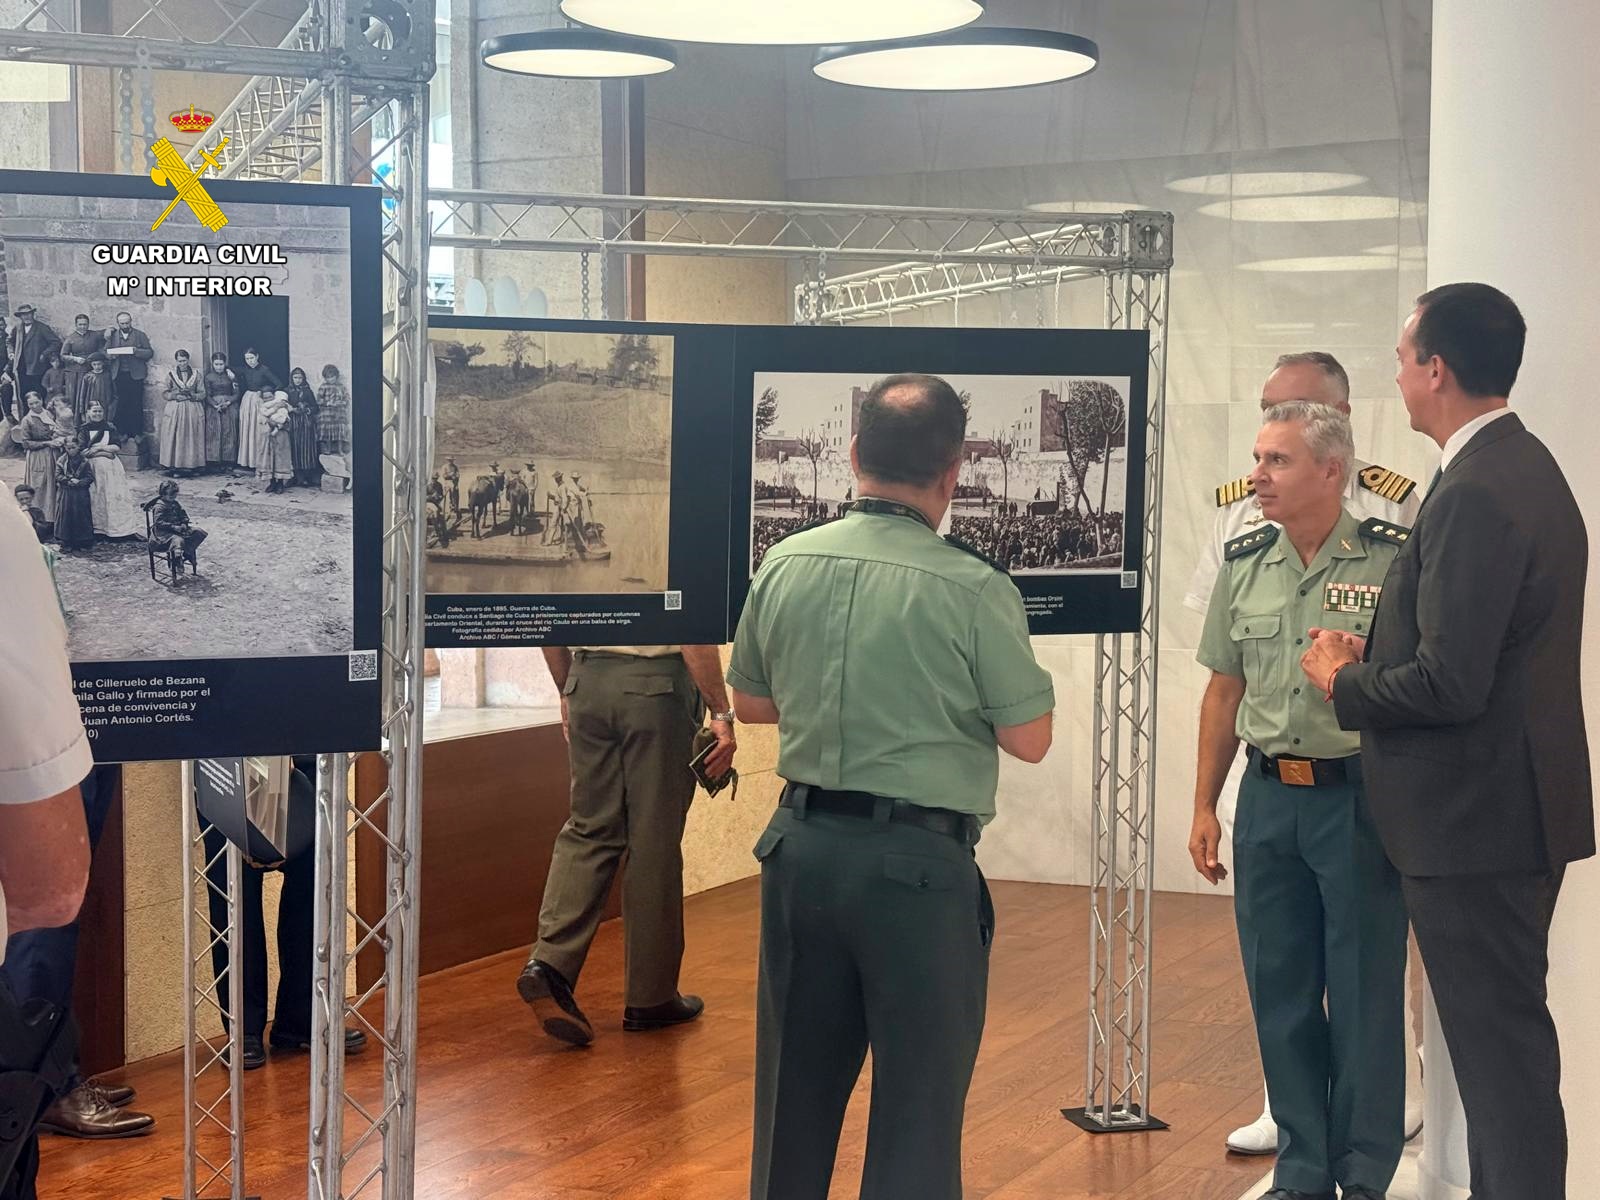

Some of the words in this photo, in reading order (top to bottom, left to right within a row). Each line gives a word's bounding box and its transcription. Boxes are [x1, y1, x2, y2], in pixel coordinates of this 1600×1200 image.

[79, 680, 93, 688] de
[95, 677, 147, 688] Cilleruelo
[150, 677, 164, 686] de
[166, 676, 206, 685] Bezana
[96, 690, 125, 700] Gallo
[127, 692, 134, 701] y
[136, 688, 178, 699] firmado
[180, 690, 199, 699] por
[200, 687, 211, 697] el
[79, 705, 105, 714] cena
[107, 703, 122, 713] de
[124, 701, 188, 712] convivencia
[190, 702, 197, 711] y
[82, 716, 108, 726] Juan
[110, 714, 153, 725] Antonio
[155, 712, 194, 723] Cortés.
